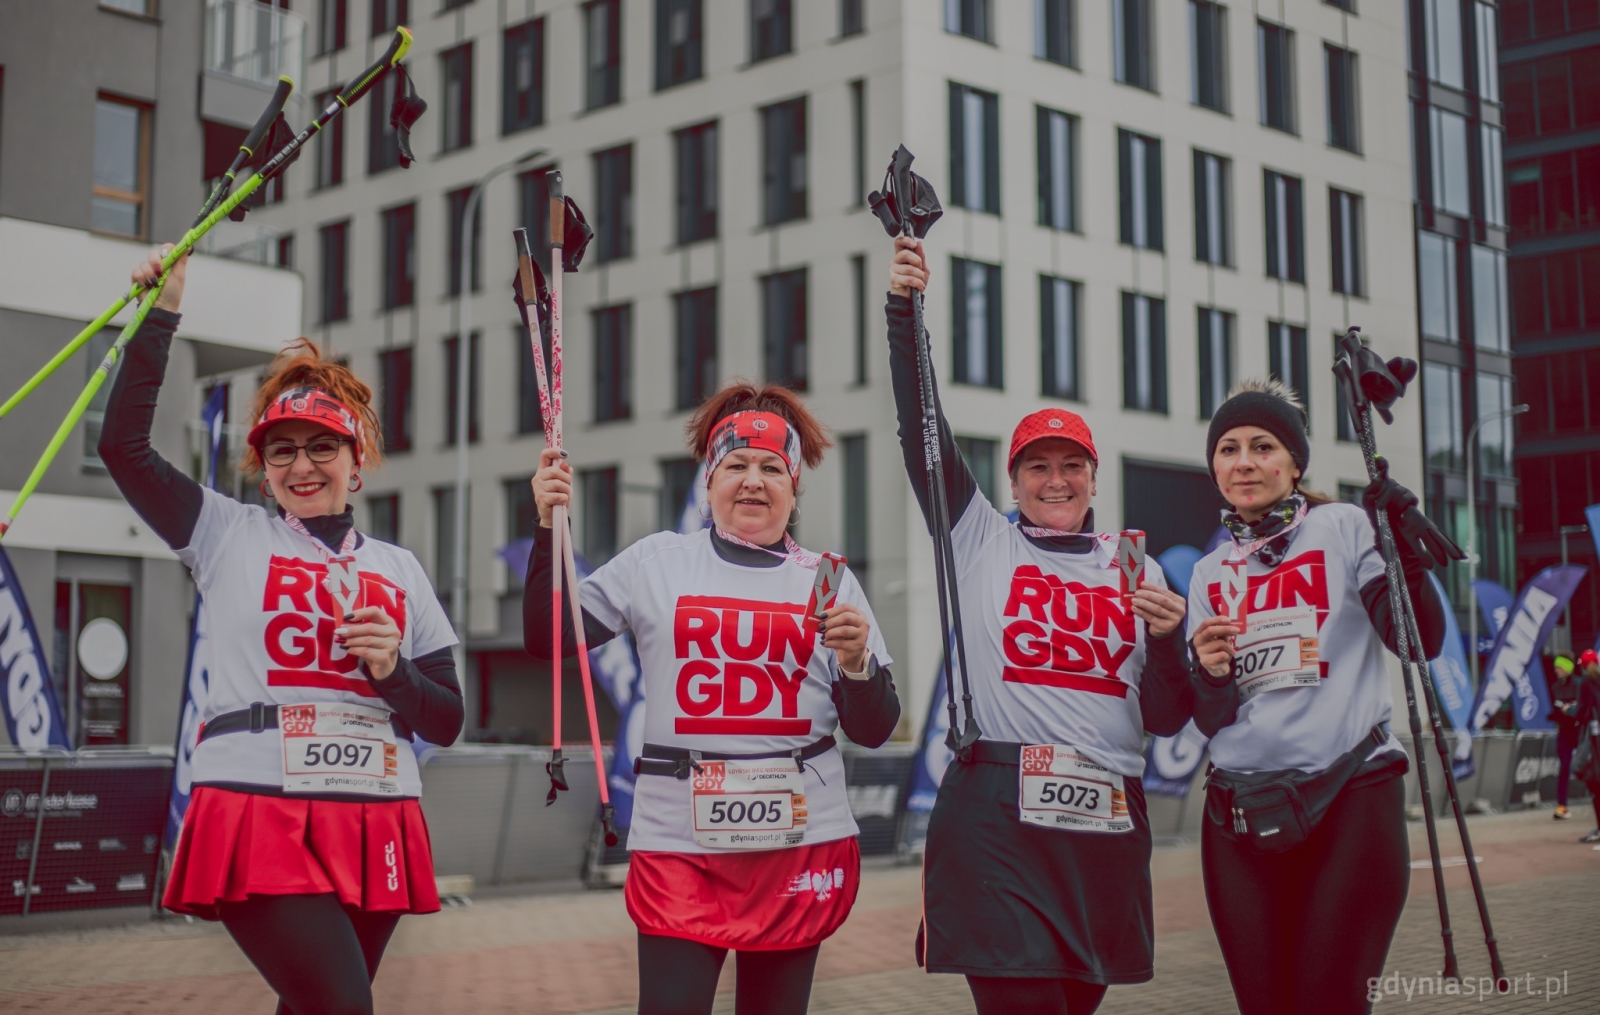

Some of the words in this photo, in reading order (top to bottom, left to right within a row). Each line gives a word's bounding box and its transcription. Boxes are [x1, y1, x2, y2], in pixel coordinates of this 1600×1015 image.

[267, 130, 309, 168] GABEL
[1209, 563, 1330, 617] UN
[1003, 577, 1137, 644] RUN
[264, 612, 363, 674] GD
[674, 606, 816, 668] RUN
[1003, 620, 1136, 680] GDY
[1235, 645, 1285, 680] 5077
[676, 660, 809, 718] GDY
[282, 707, 316, 721] RUN
[282, 721, 316, 733] GDY
[303, 742, 373, 768] 5097
[1022, 748, 1054, 760] RUN
[1022, 760, 1054, 771] GDY
[324, 777, 375, 787] gdyniasport.pl
[693, 778, 726, 790] GDY
[1039, 782, 1100, 810] 5073
[709, 800, 782, 823] 5005
[1056, 815, 1102, 827] gdyniasport.pl
[730, 834, 781, 843] gdyniasport.pl
